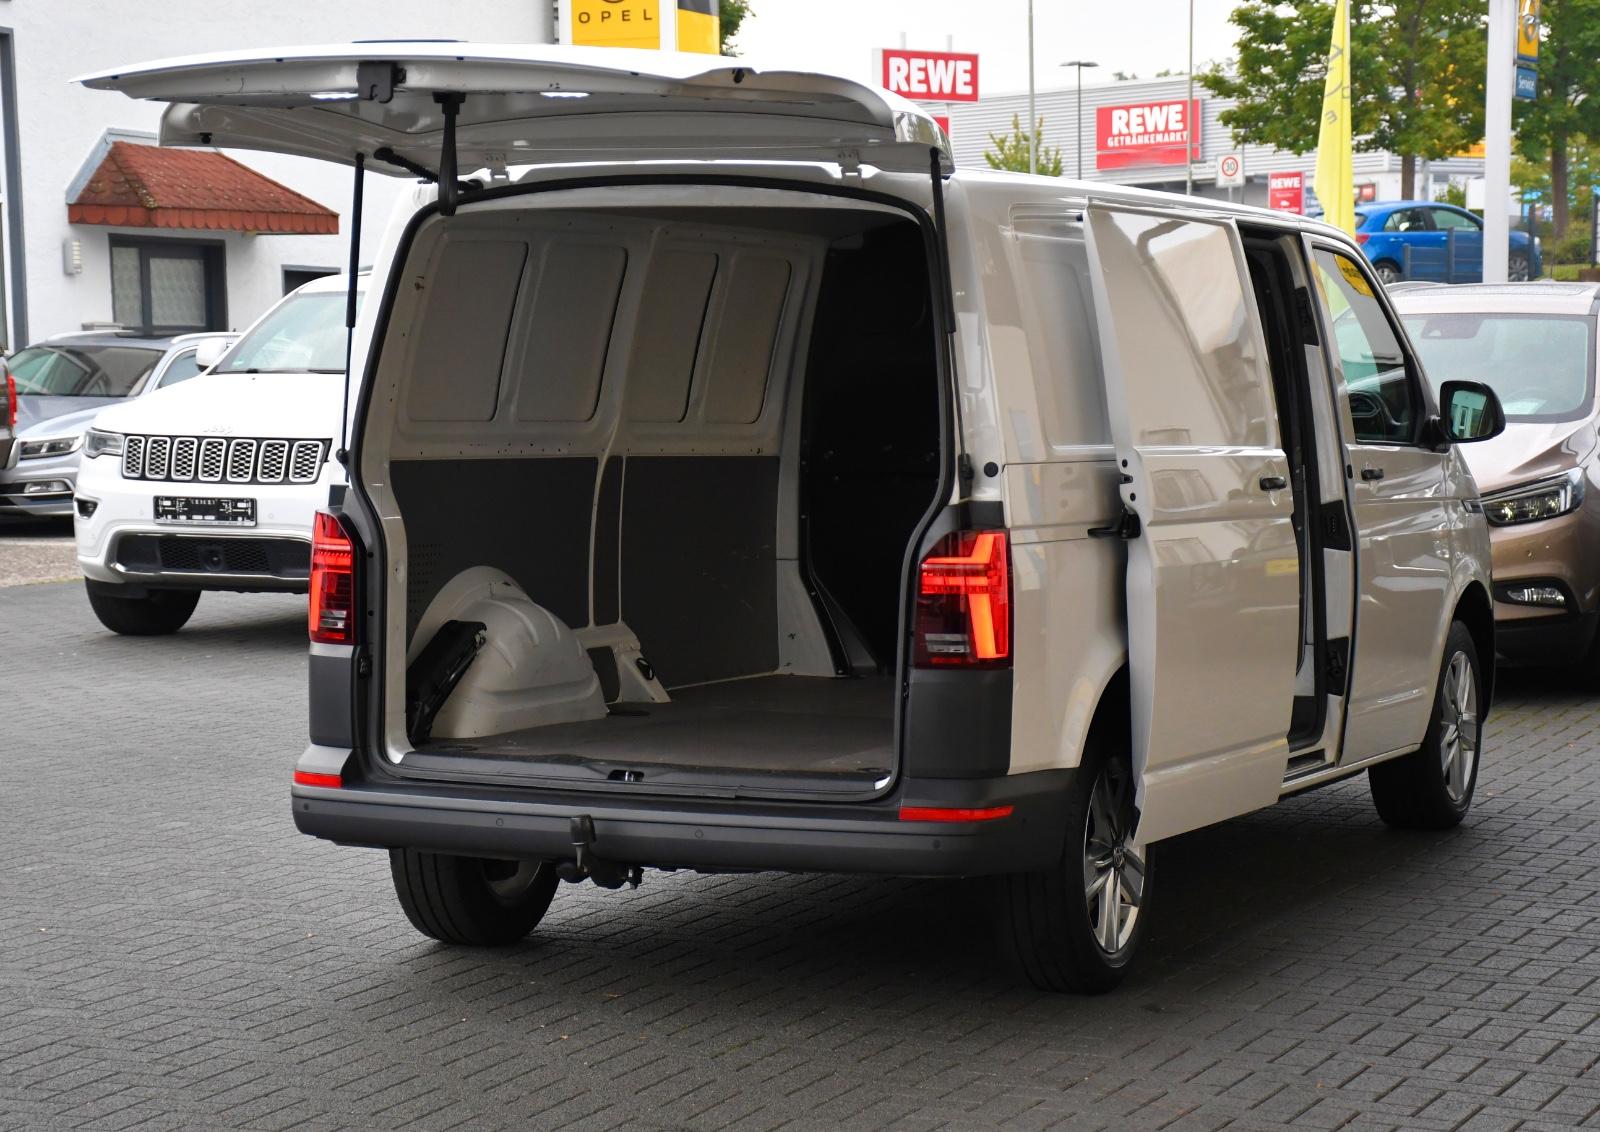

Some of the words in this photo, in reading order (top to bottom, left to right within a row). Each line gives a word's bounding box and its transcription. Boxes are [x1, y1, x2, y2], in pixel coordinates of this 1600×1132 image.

[578, 9, 653, 24] OPEL
[888, 56, 973, 95] REWE
[1518, 75, 1535, 90] Service
[1111, 104, 1184, 135] REWE
[1107, 131, 1188, 147] GETRÄNKEMARKT
[1226, 161, 1235, 171] 30
[1270, 177, 1301, 189] REWE
